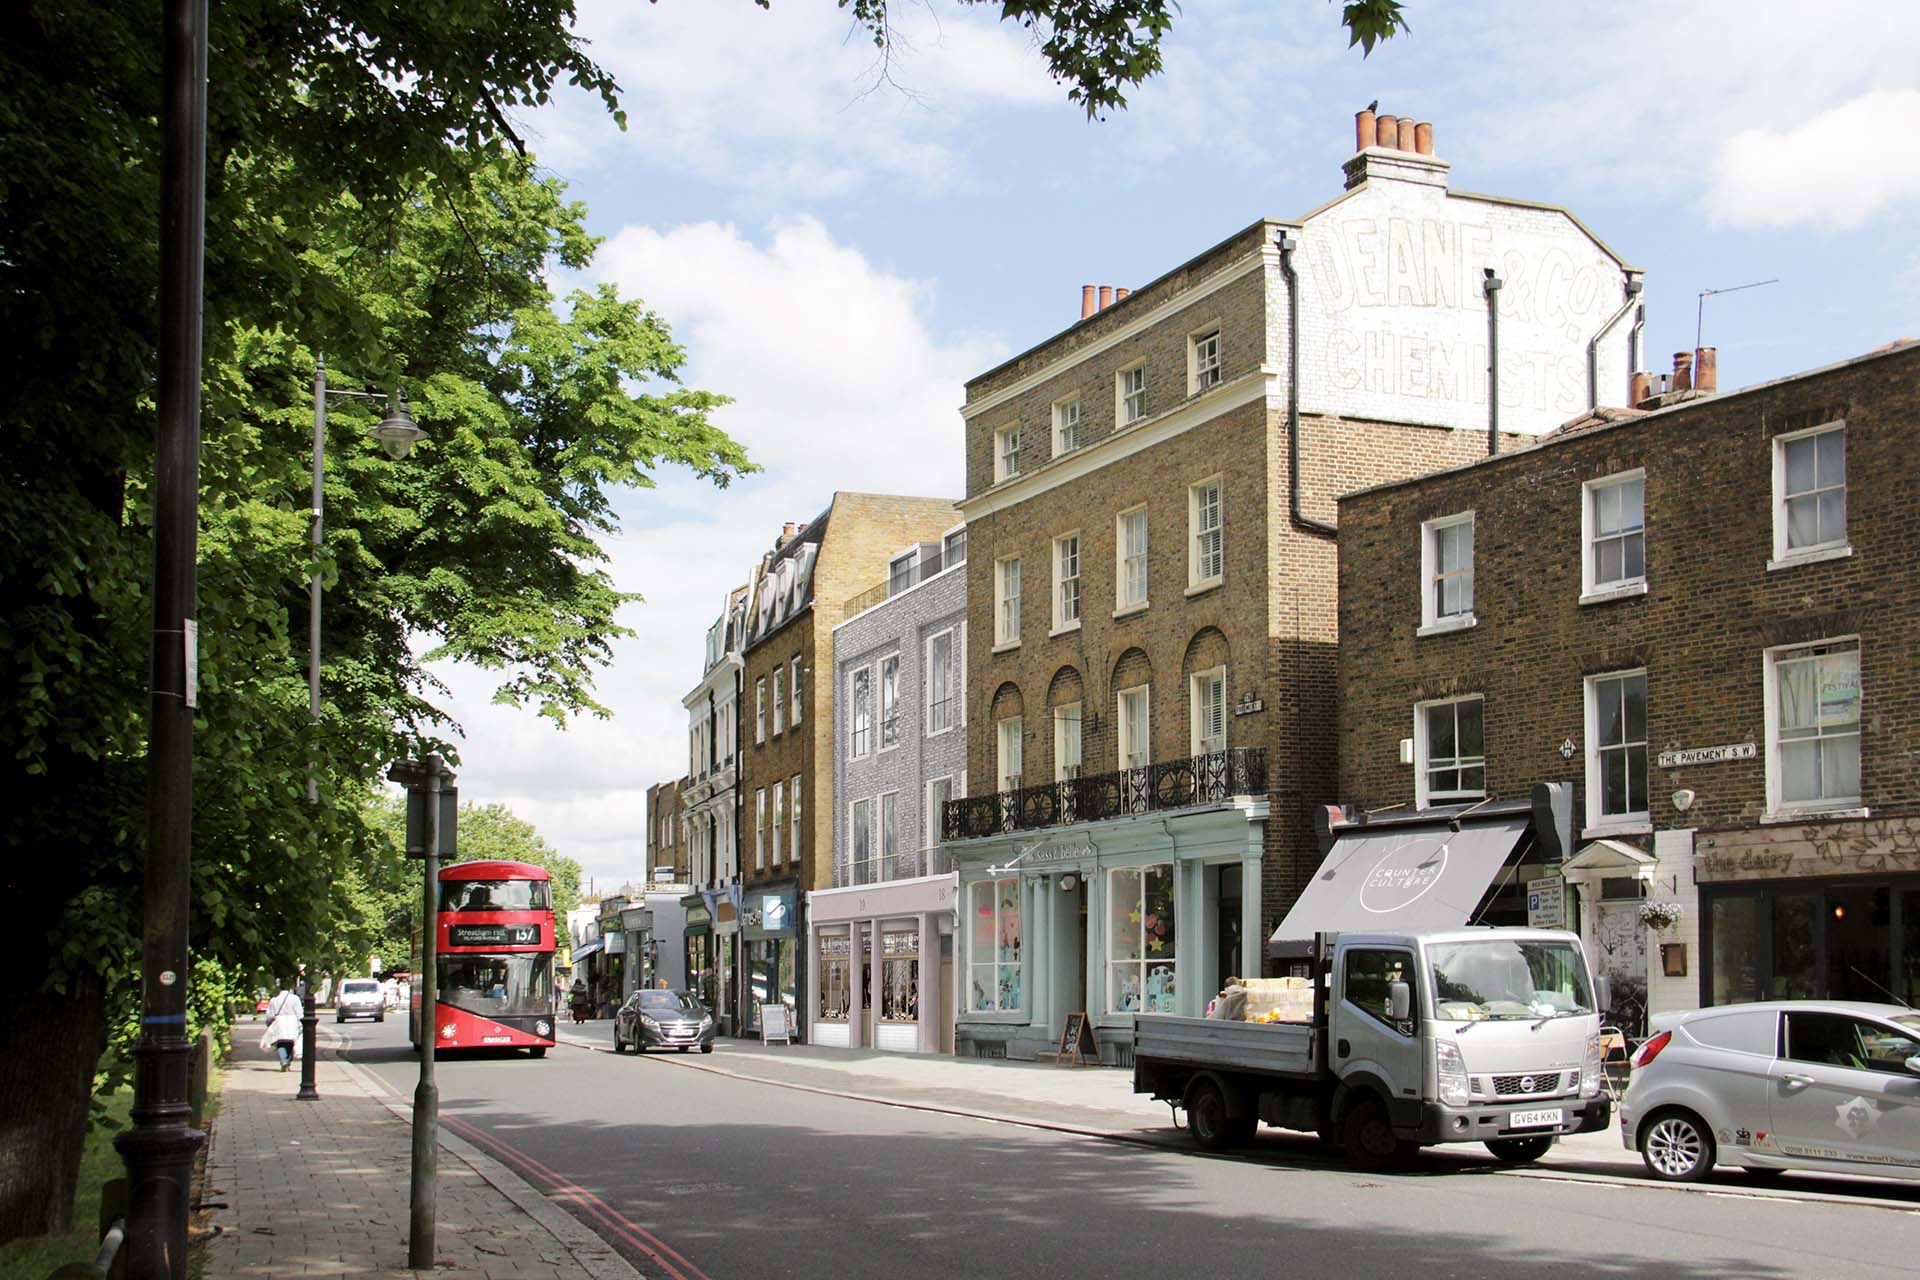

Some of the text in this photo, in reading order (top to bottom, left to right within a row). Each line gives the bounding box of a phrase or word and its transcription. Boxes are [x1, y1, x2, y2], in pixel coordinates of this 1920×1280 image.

[1303, 217, 1493, 316] DEANE
[1326, 328, 1586, 414] CHEMISTS
[1660, 754, 1677, 765] THE
[1681, 748, 1727, 762] PAVEMENT
[1741, 848, 1794, 873] dairy
[1375, 866, 1436, 878] COUNTER
[1369, 877, 1431, 888] CULTURE
[1531, 896, 1538, 909] P
[515, 927, 535, 941] 137
[1514, 1111, 1559, 1125] GV64 KKN
